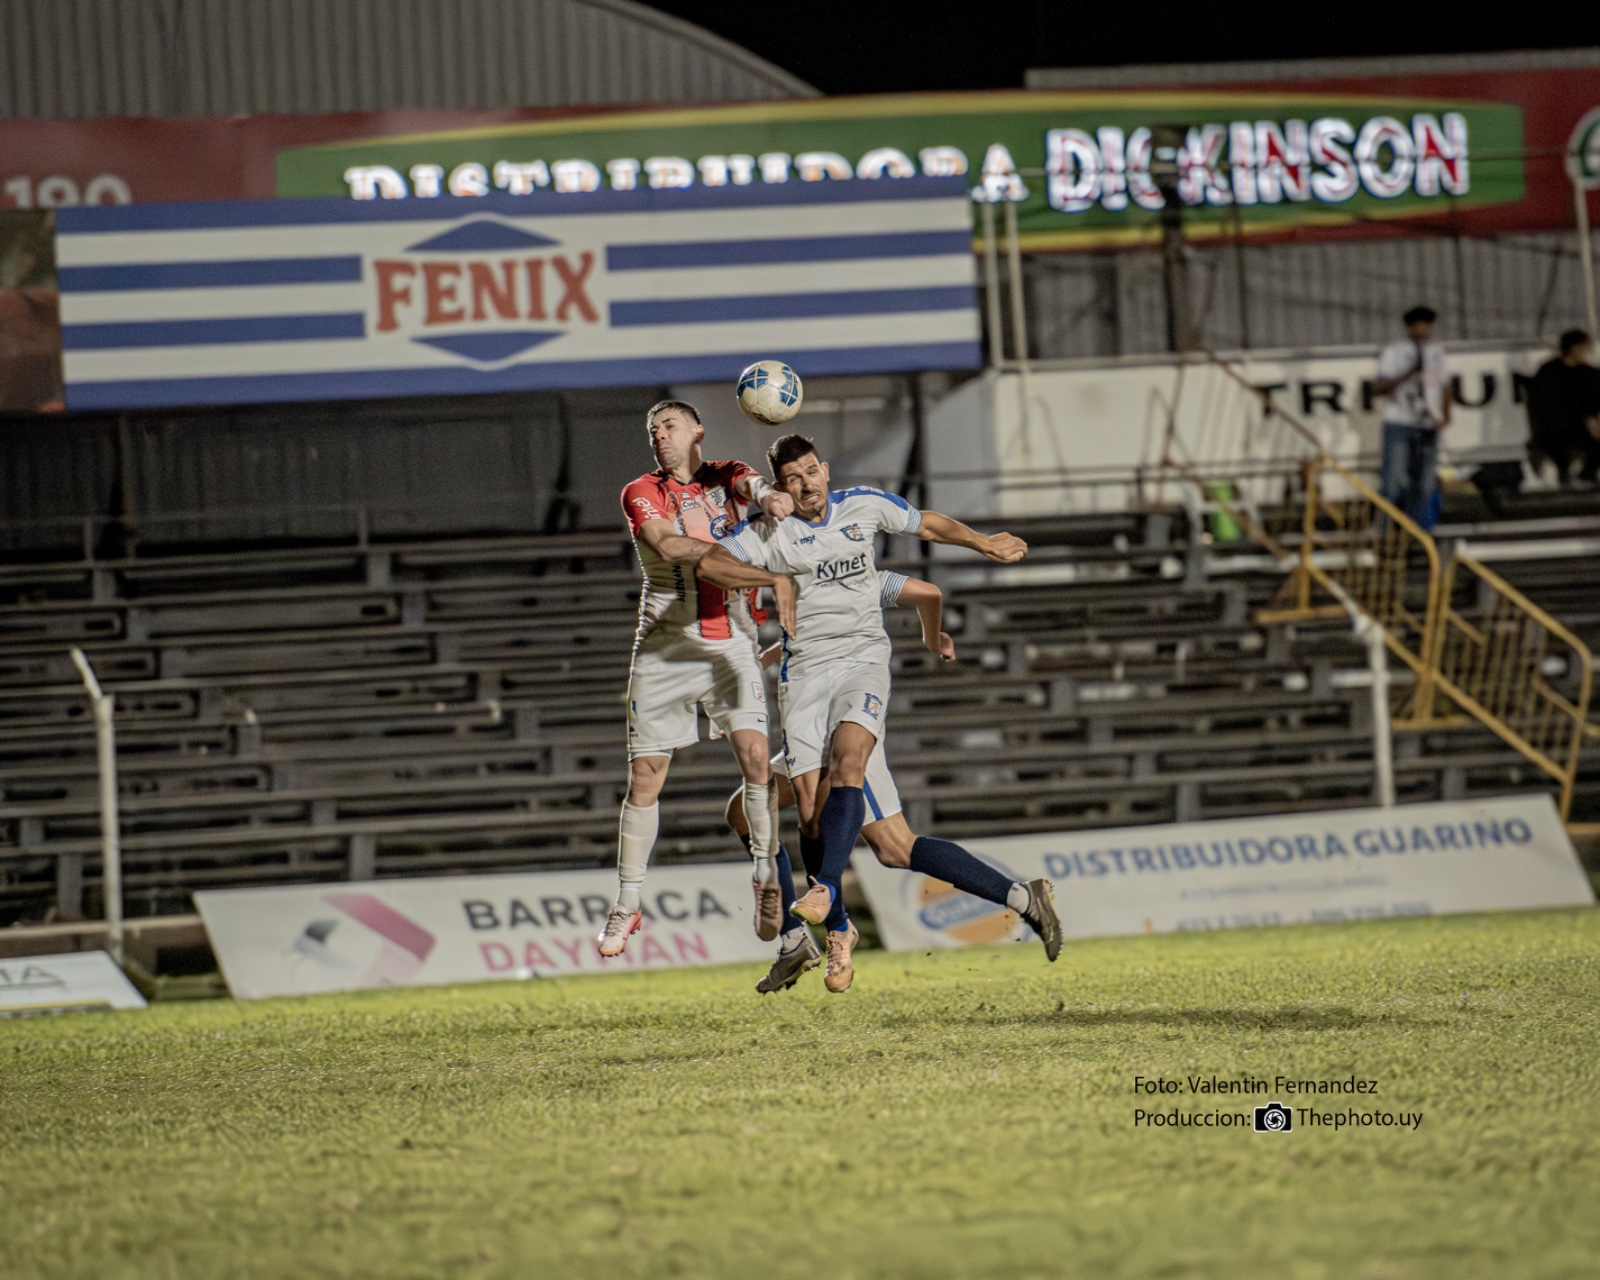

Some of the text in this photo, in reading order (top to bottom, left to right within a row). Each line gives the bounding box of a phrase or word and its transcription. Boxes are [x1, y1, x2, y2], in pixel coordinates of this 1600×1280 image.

[1046, 112, 1470, 213] DICKINSON
[373, 249, 600, 332] FENIX
[816, 551, 867, 580] Kynet
[1042, 818, 1533, 881] DISTRIBUIDORA GUARINO
[463, 888, 730, 931] BARRCA
